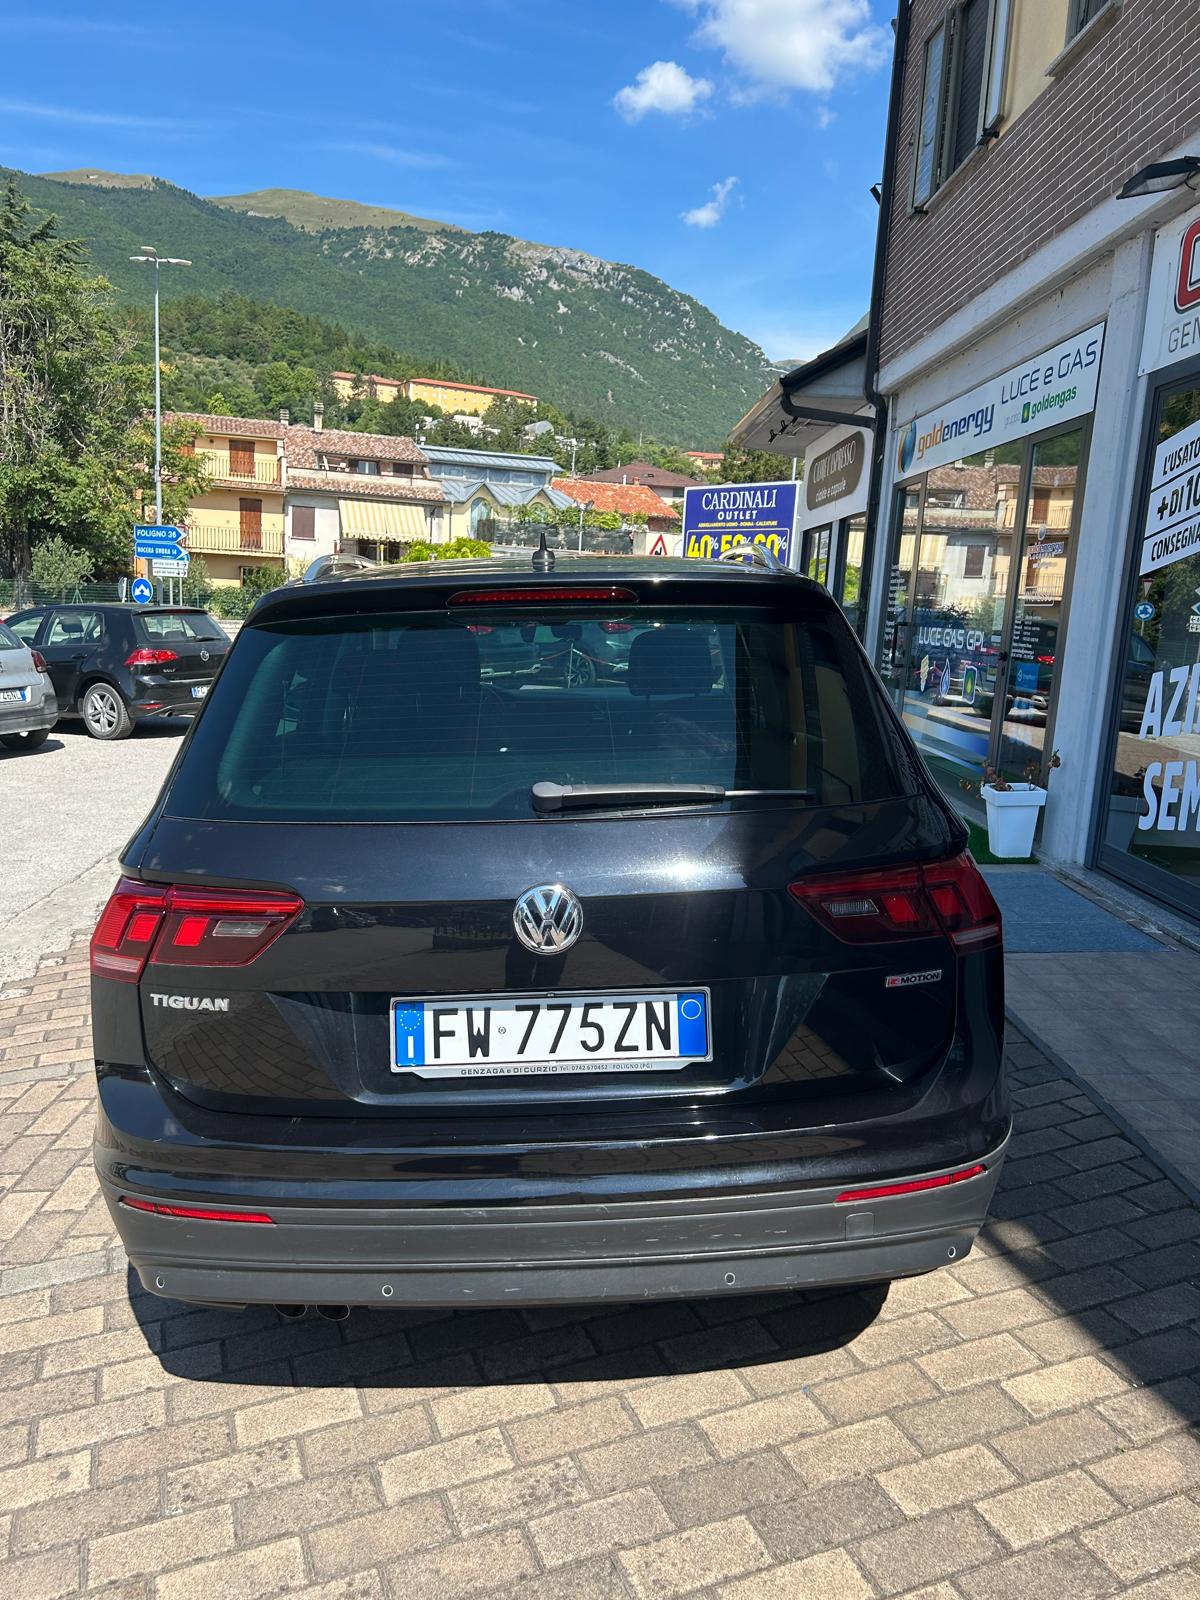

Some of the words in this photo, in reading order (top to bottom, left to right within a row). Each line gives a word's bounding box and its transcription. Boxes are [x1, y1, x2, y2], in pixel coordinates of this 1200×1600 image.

[1001, 368, 1041, 405] LUCE
[1043, 366, 1054, 385] e
[1058, 339, 1098, 380] GAS
[1030, 386, 1077, 419] goldengas
[917, 403, 995, 460] goldenergy
[702, 489, 777, 510] CARDINALI
[717, 510, 757, 520] OUTLET
[137, 529, 166, 538] FOLIGNO
[918, 626, 941, 646] LUCE
[943, 627, 964, 649] GAS
[966, 630, 987, 652] GPL
[149, 993, 230, 1012] TIGUAN
[433, 1007, 491, 1059] FW
[515, 1001, 671, 1054] 775ZN
[460, 1067, 505, 1076] GENZAGA
